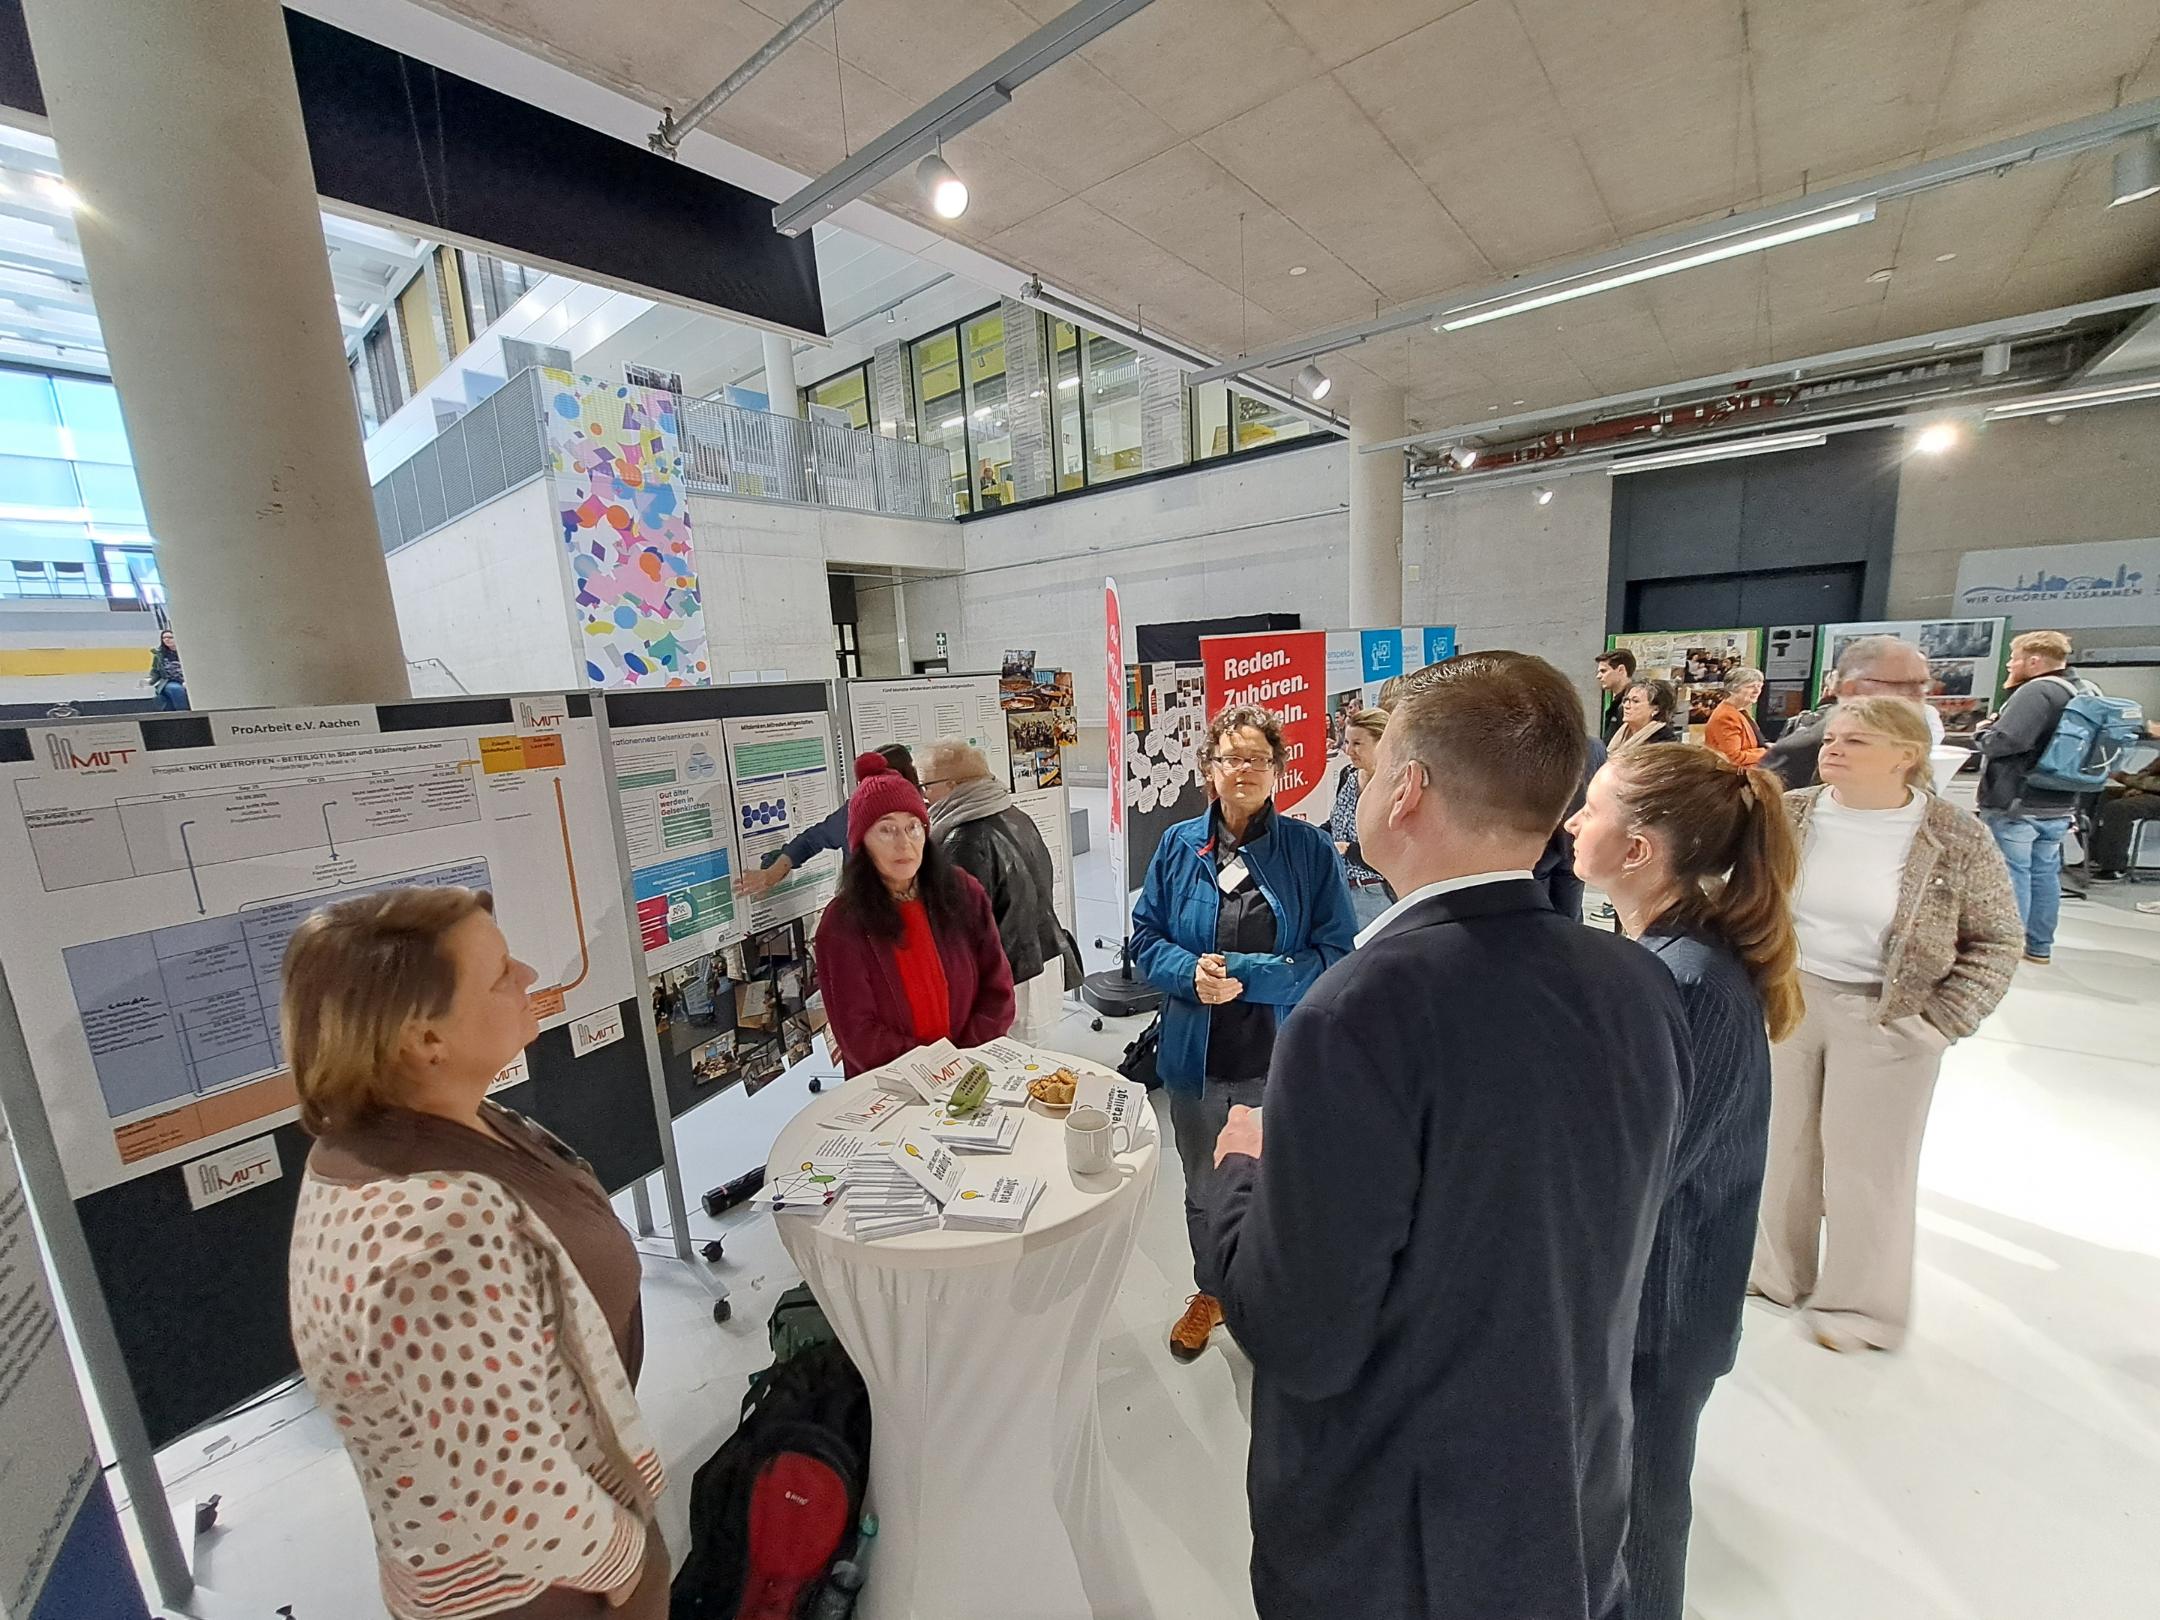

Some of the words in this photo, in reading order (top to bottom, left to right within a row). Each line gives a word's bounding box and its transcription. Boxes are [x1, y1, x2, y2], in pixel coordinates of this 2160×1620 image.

[1967, 596, 1989, 604] WIR
[1995, 592, 2058, 603] GEHÖREN
[2064, 588, 2143, 600] ZUSAMMEN
[1224, 649, 1291, 681] Reden.
[1223, 674, 1309, 708] Zuhören.
[1272, 703, 1308, 725] eln.
[231, 722, 292, 735] ProArbeit
[295, 721, 316, 731] e.V.
[319, 718, 361, 729] Aachen
[657, 731, 699, 742] Gelsenkirchen
[188, 762, 217, 771] NICHT
[220, 758, 275, 769] BETROFFEN
[282, 752, 327, 763] BETEILIGT!
[337, 750, 357, 758] Stadt
[358, 748, 372, 756] und
[1272, 768, 1309, 796] itik.
[659, 792, 673, 800] Gut
[673, 788, 689, 797] älter
[660, 797, 686, 809] werden
[661, 801, 710, 816] Gelsenkirchen
